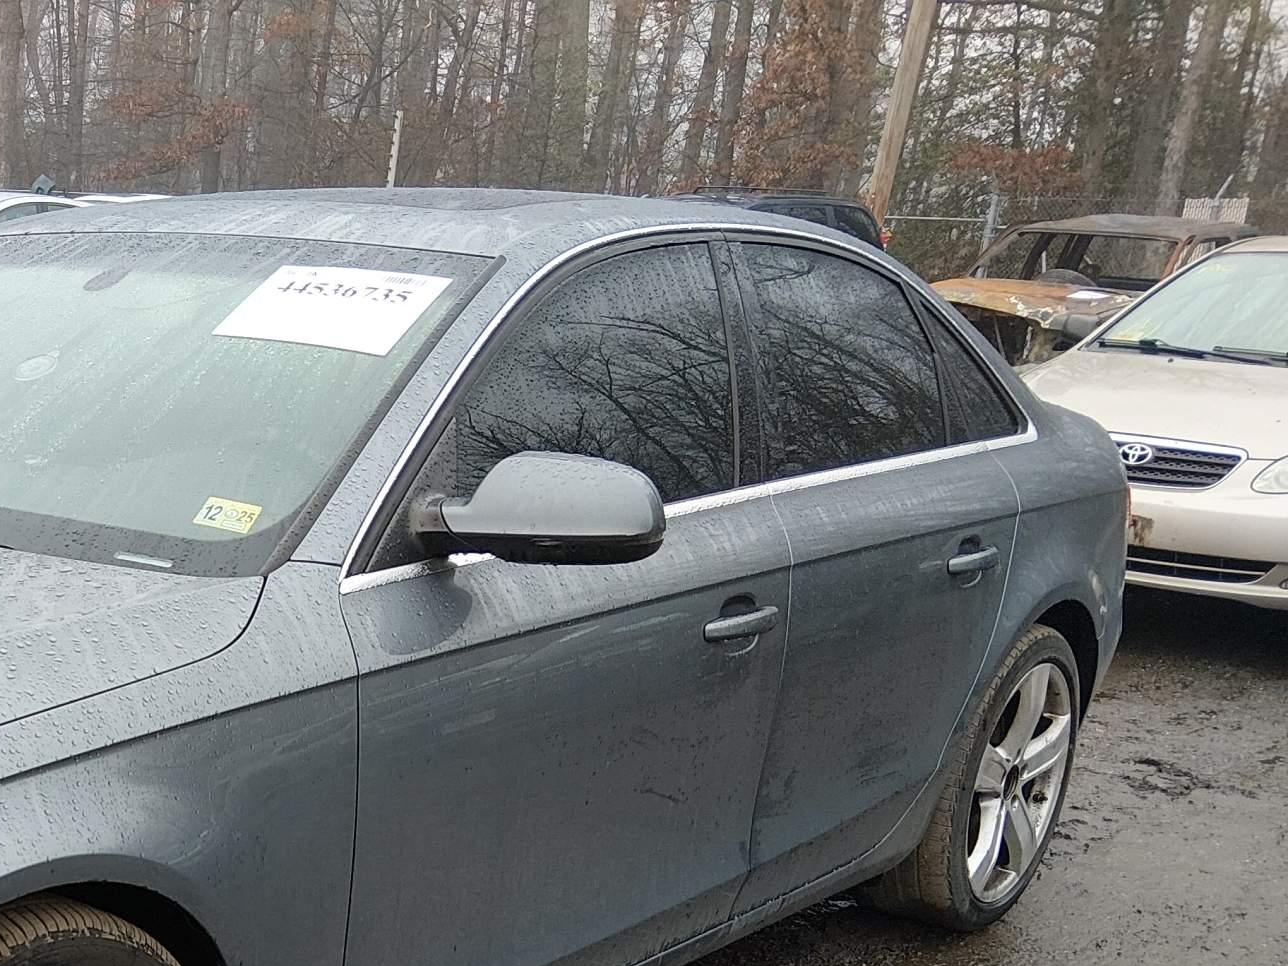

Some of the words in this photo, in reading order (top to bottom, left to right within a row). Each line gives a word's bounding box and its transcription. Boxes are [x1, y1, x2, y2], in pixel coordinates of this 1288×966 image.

[277, 281, 413, 303] 44536735
[203, 504, 223, 521] 12
[236, 510, 255, 523] 25
